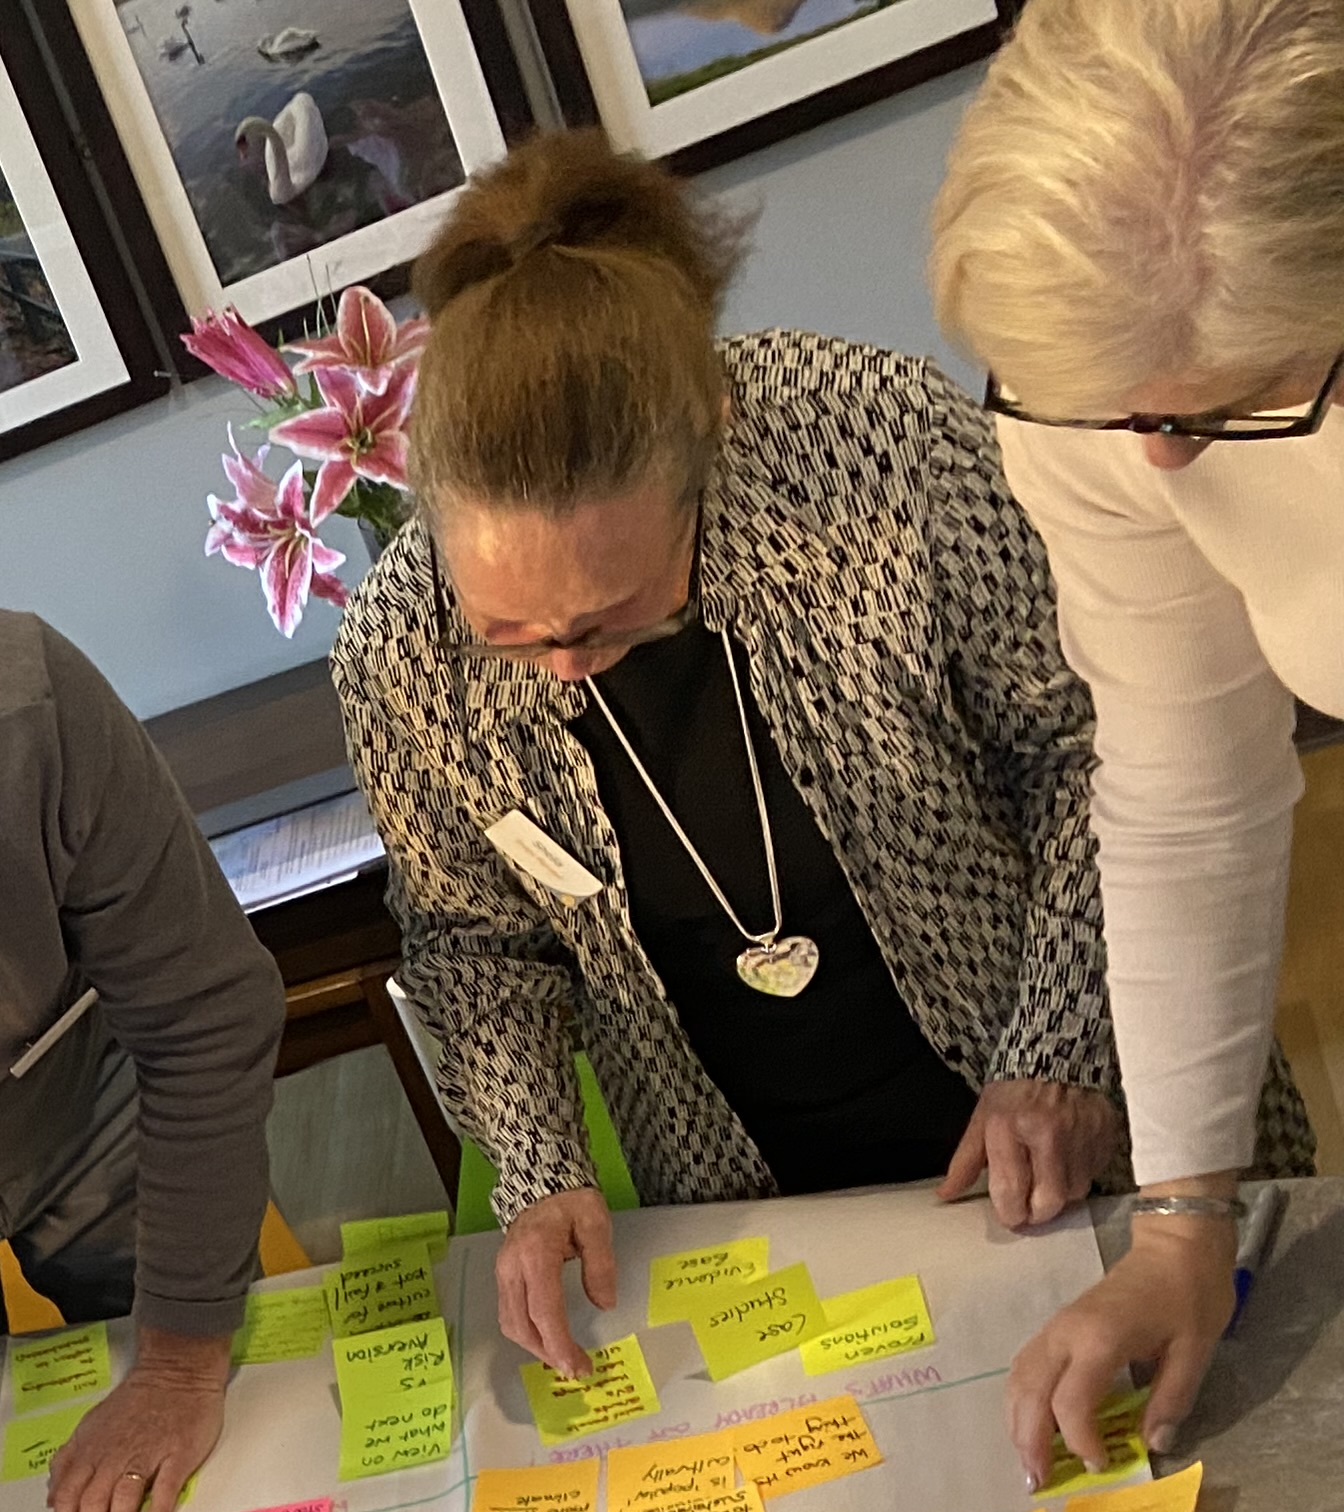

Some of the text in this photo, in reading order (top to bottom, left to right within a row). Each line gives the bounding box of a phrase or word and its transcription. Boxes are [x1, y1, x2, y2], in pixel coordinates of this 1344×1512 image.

[664, 1261, 756, 1290] Evidence
[344, 1287, 430, 1324] culture for
[709, 1288, 787, 1328] Studies
[755, 1313, 806, 1343] Case
[819, 1315, 919, 1350] Solutions
[346, 1332, 428, 1364] Aversion
[402, 1351, 445, 1371] Risk
[842, 1334, 926, 1362] Proven
[365, 1403, 447, 1431] do next
[648, 1394, 817, 1442] ALREADY OUT
[804, 1413, 856, 1433] thing
[365, 1420, 446, 1449] what we
[778, 1429, 866, 1463] the right
[362, 1442, 441, 1468] View on
[642, 1455, 730, 1482] culturally
[784, 1447, 869, 1478] We know
[711, 1476, 726, 1490] is
[514, 1491, 581, 1506] climate
